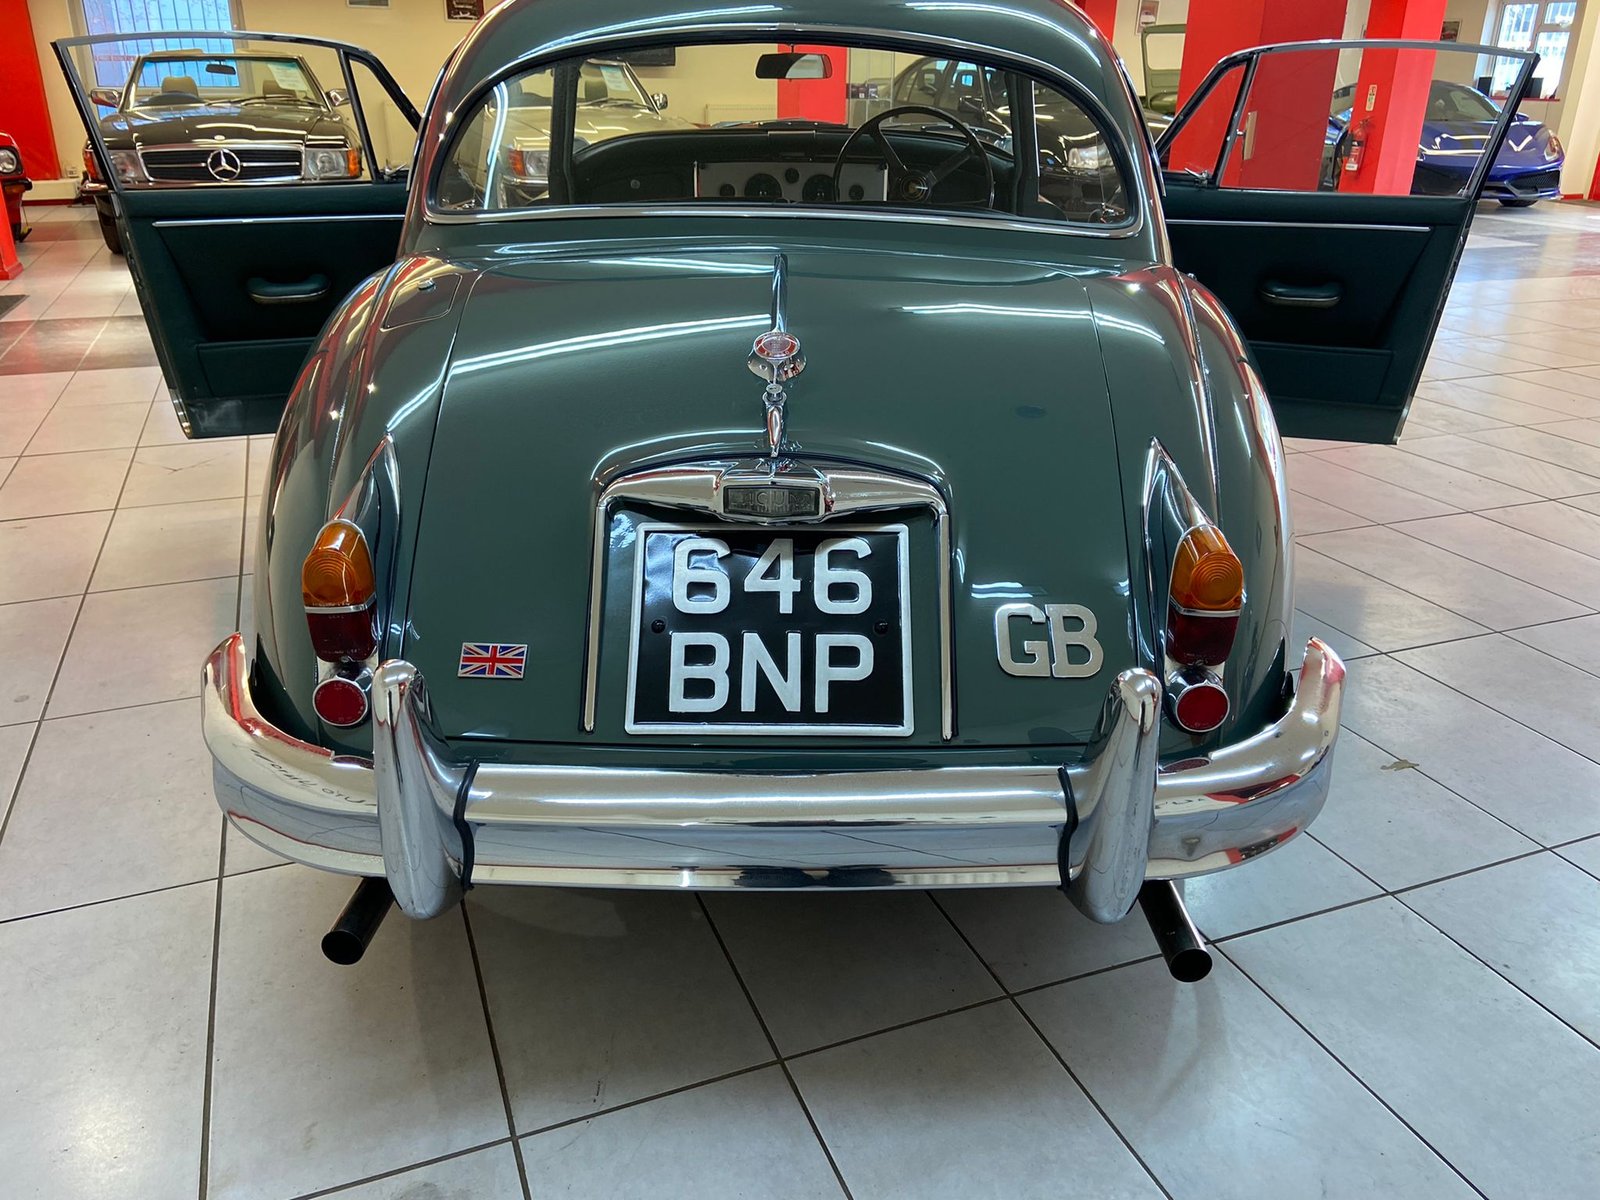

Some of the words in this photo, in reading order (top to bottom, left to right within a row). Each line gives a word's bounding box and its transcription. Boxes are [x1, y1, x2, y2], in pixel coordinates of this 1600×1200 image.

[672, 538, 873, 614] 646
[669, 631, 874, 713] BNP
[995, 603, 1104, 678] GB
